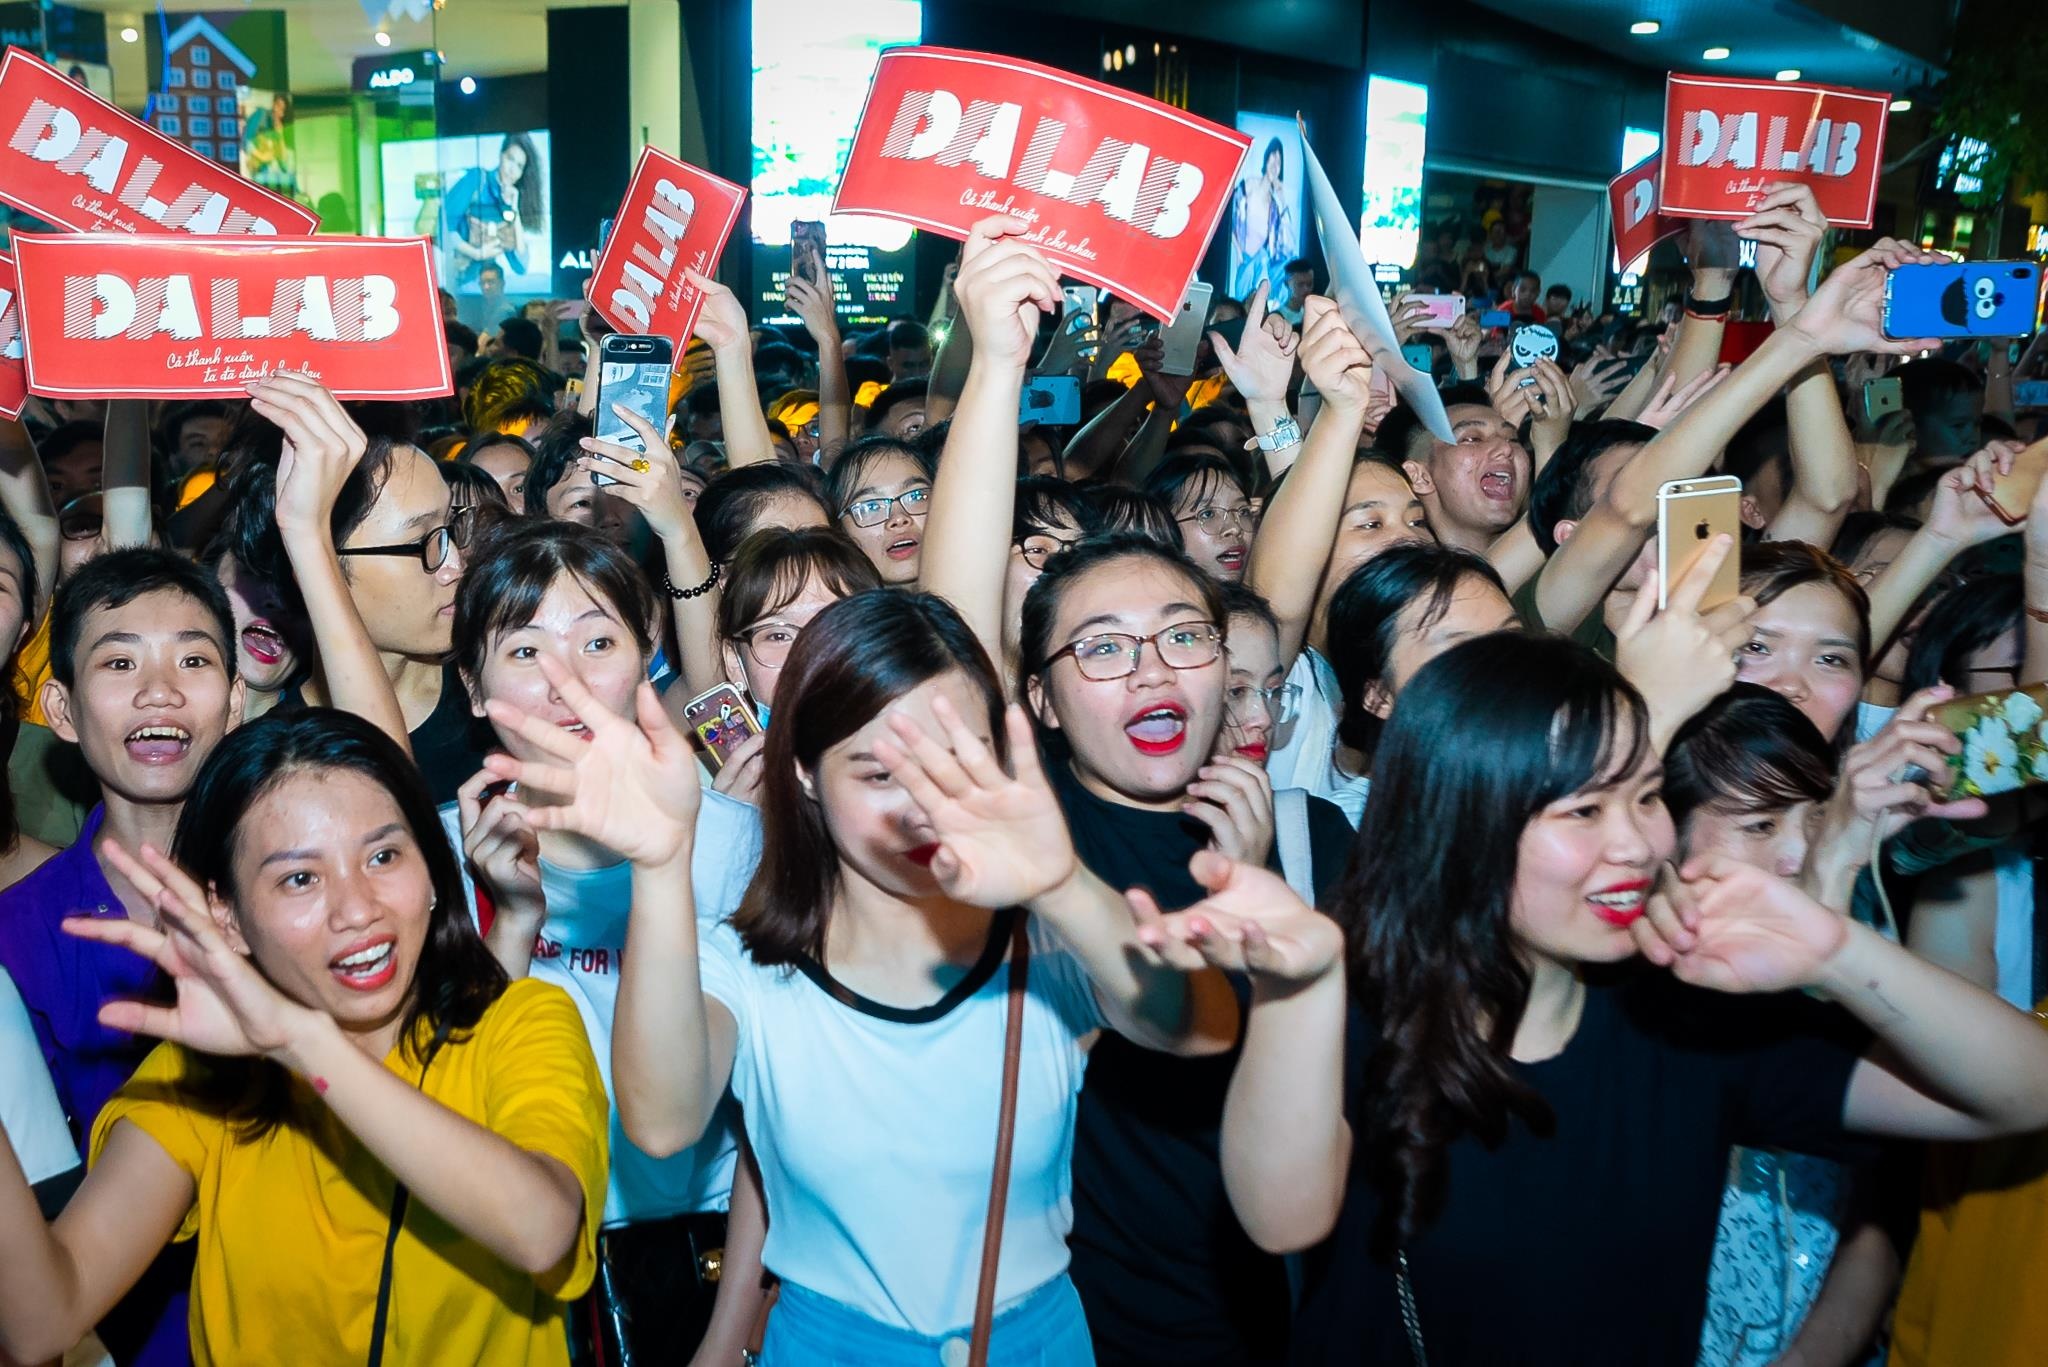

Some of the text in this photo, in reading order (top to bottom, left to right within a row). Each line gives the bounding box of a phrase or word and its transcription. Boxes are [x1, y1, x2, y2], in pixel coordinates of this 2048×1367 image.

[8, 97, 129, 195] DA
[880, 90, 1205, 239] DA LAB
[1677, 110, 1862, 177] DA LAB
[559, 250, 599, 269] AL
[64, 273, 204, 340] DA
[211, 275, 401, 342] LAB
[184, 347, 222, 367] thanh
[203, 367, 217, 382] ta
[569, 947, 609, 975] FOR
